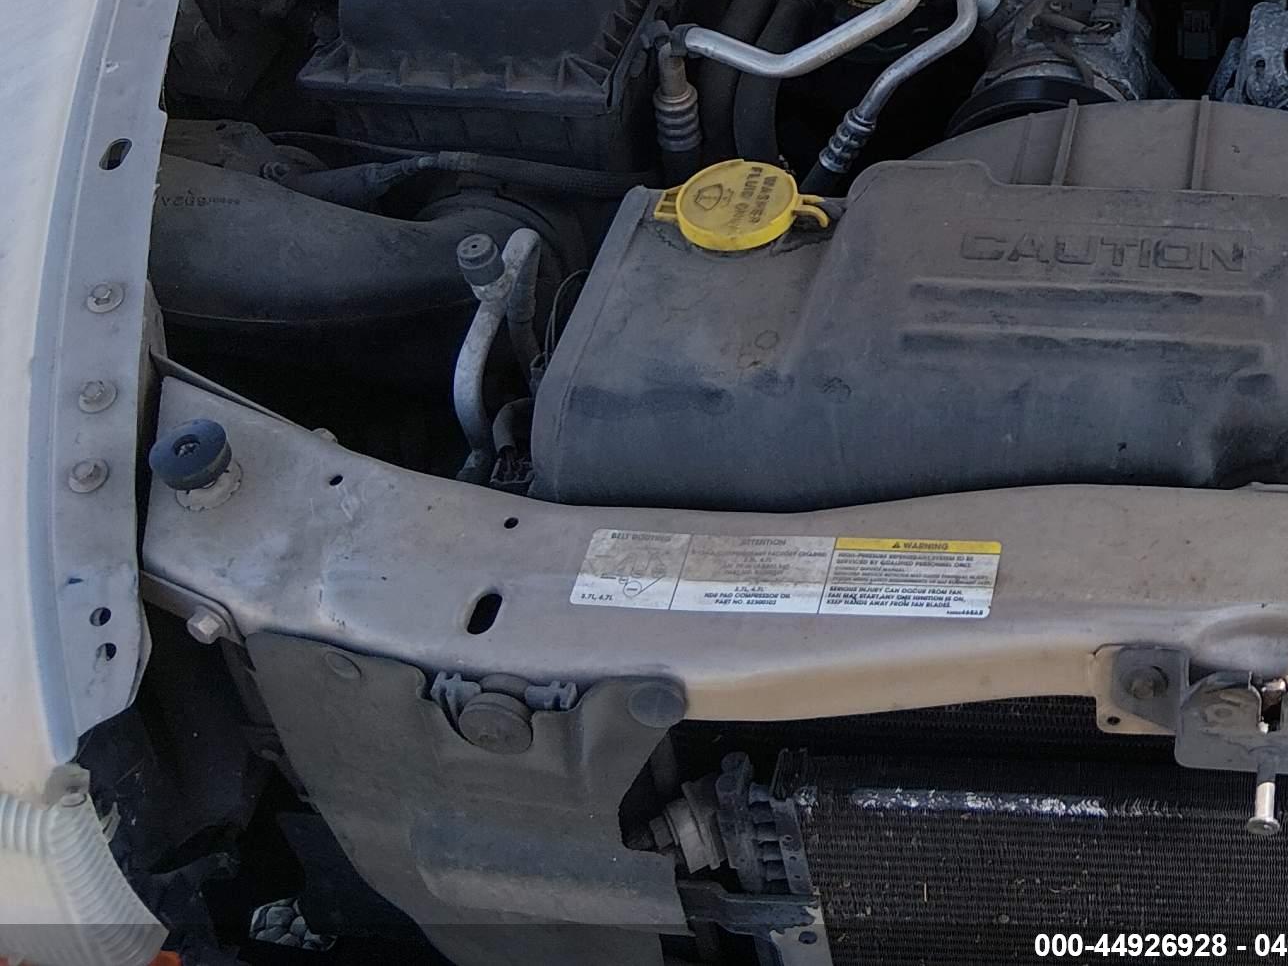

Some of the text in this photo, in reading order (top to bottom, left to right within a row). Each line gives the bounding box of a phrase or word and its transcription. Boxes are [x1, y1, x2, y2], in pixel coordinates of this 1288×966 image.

[959, 232, 1249, 273] CAUTION
[611, 532, 630, 540] BELT
[740, 538, 787, 547] ATTENTION
[904, 541, 949, 550] WARNING
